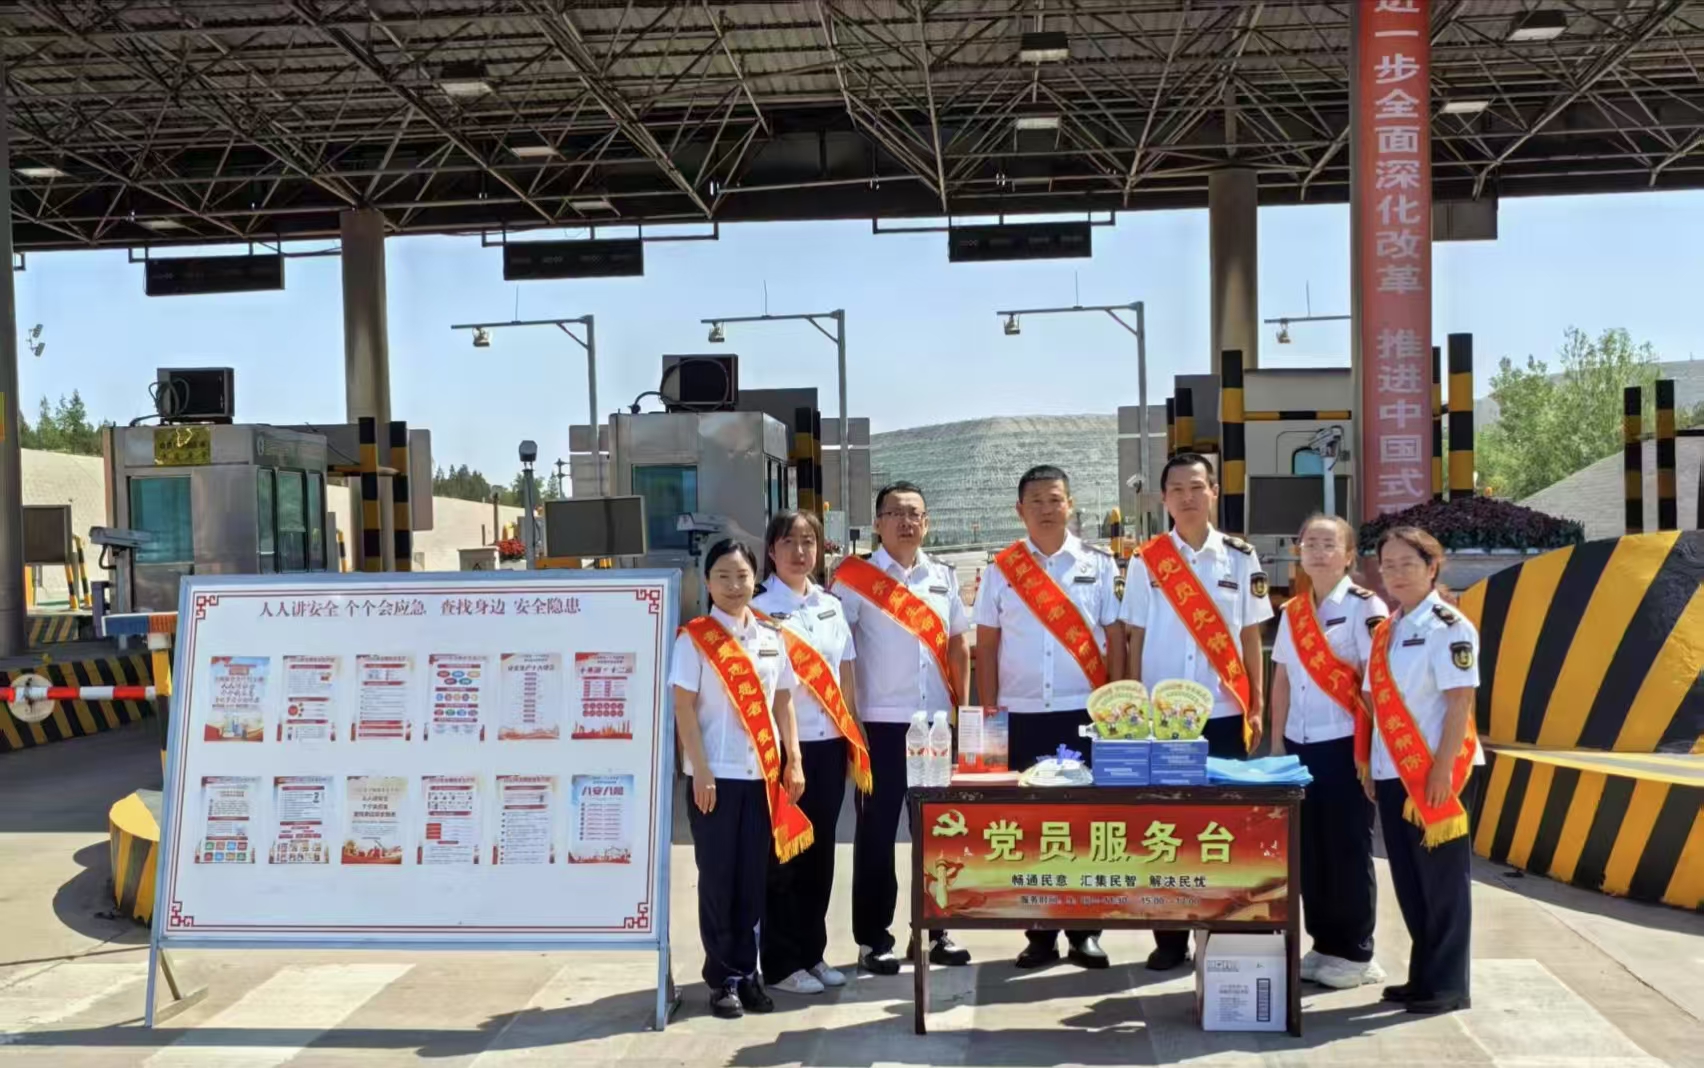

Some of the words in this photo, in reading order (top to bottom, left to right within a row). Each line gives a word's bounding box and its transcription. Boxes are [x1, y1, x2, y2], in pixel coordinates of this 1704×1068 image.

[259, 600, 339, 618] 人人讲安全
[344, 599, 428, 617] 个个会应急
[440, 598, 506, 616] 查找身边
[513, 597, 582, 615] 安全隐患
[1157, 557, 1242, 682] 党员先锋岗
[982, 819, 1236, 864] 党员服务台
[1011, 874, 1068, 887] 畅通民意
[1080, 874, 1137, 888] 汇集民智
[1149, 875, 1207, 888] 解决民忧
